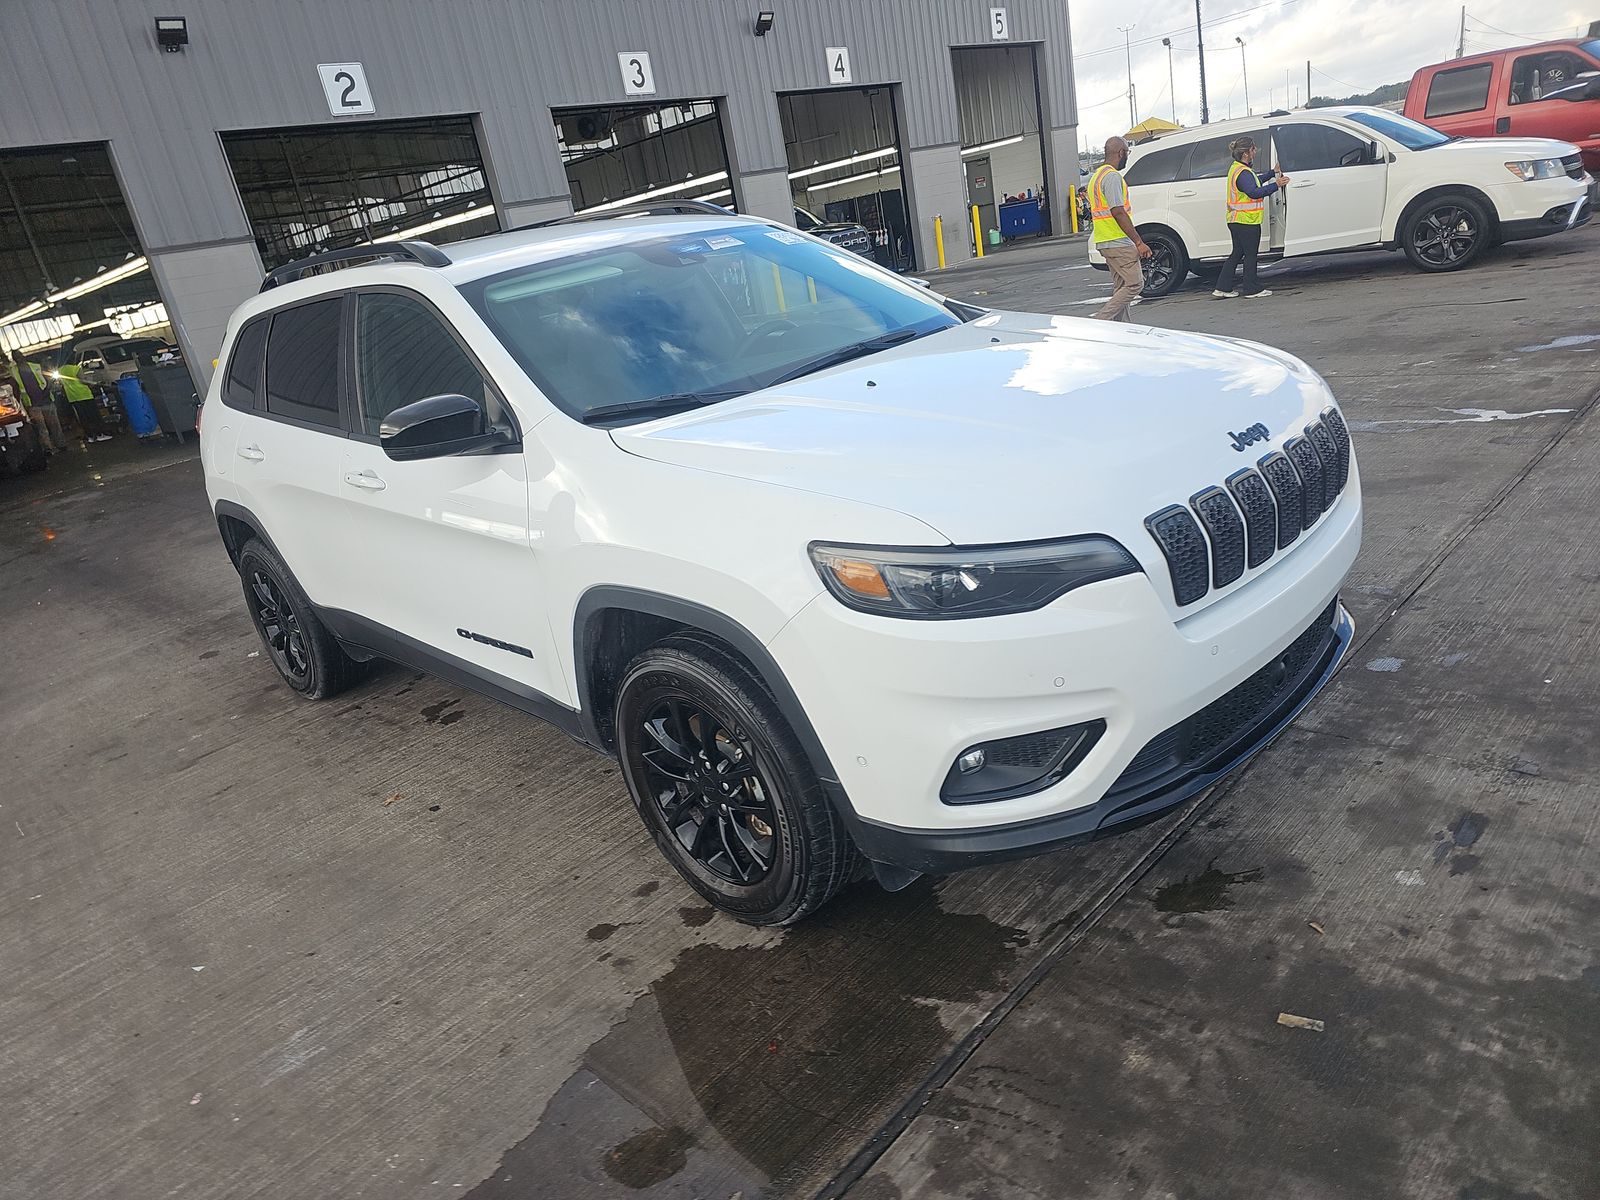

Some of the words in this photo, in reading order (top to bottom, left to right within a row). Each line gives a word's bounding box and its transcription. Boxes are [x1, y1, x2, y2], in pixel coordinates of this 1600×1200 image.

[995, 12, 1004, 35] 5
[629, 58, 646, 88] 3
[834, 53, 846, 78] 4
[334, 71, 362, 107] 2
[1227, 422, 1271, 452] Jeep
